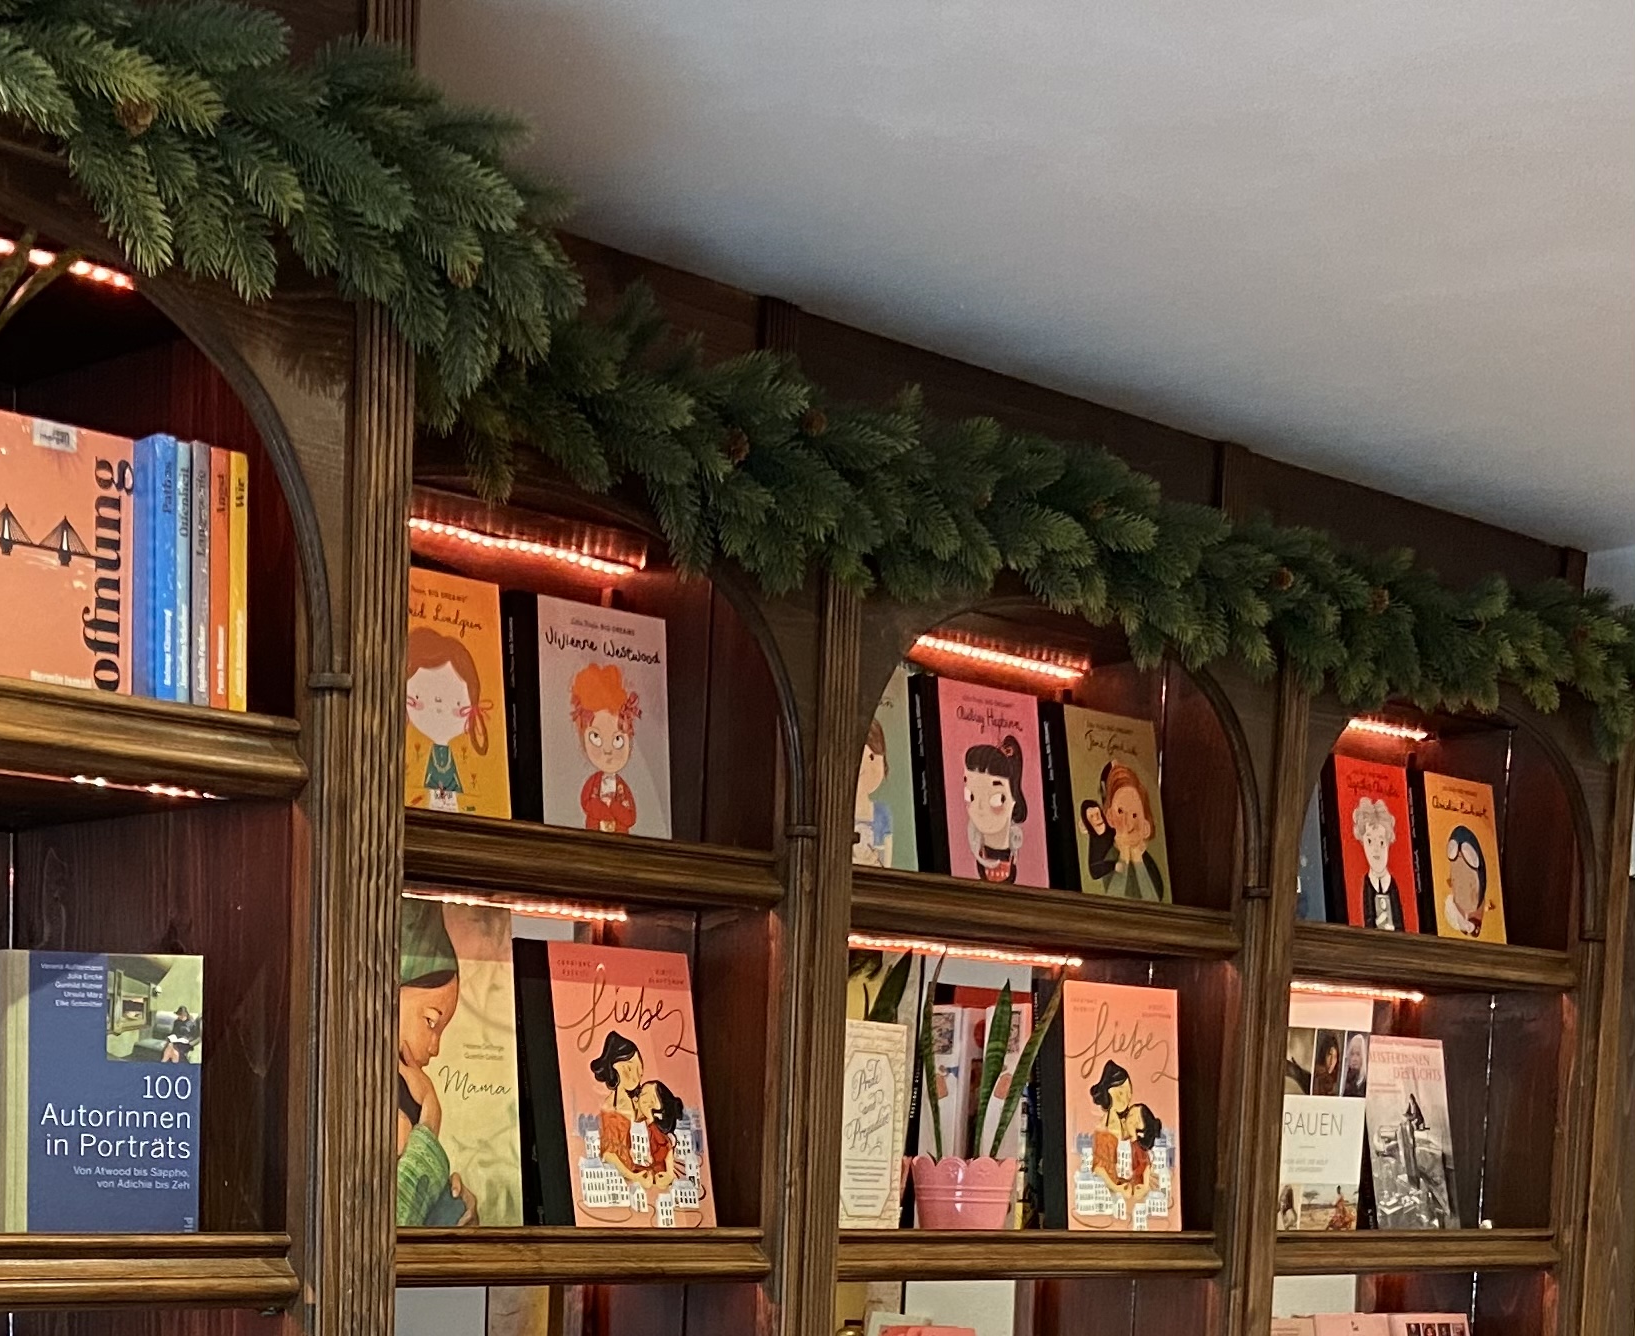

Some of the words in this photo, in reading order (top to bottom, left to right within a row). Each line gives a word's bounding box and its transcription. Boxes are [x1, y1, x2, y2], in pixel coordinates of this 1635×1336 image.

[544, 625, 598, 653] Vivienne
[602, 640, 662, 666] Westwood
[142, 1075, 192, 1100] 100
[438, 1065, 512, 1101] Mama
[40, 1103, 192, 1130] Autorinnen
[1283, 1111, 1344, 1137] RAUEN
[46, 1134, 68, 1156] in
[79, 1133, 191, 1160] Porträts
[73, 1165, 92, 1177] Von
[133, 1167, 148, 1178] bis
[97, 1179, 114, 1189] von
[154, 1179, 169, 1190] bis
[171, 1180, 190, 1191] Zeh
